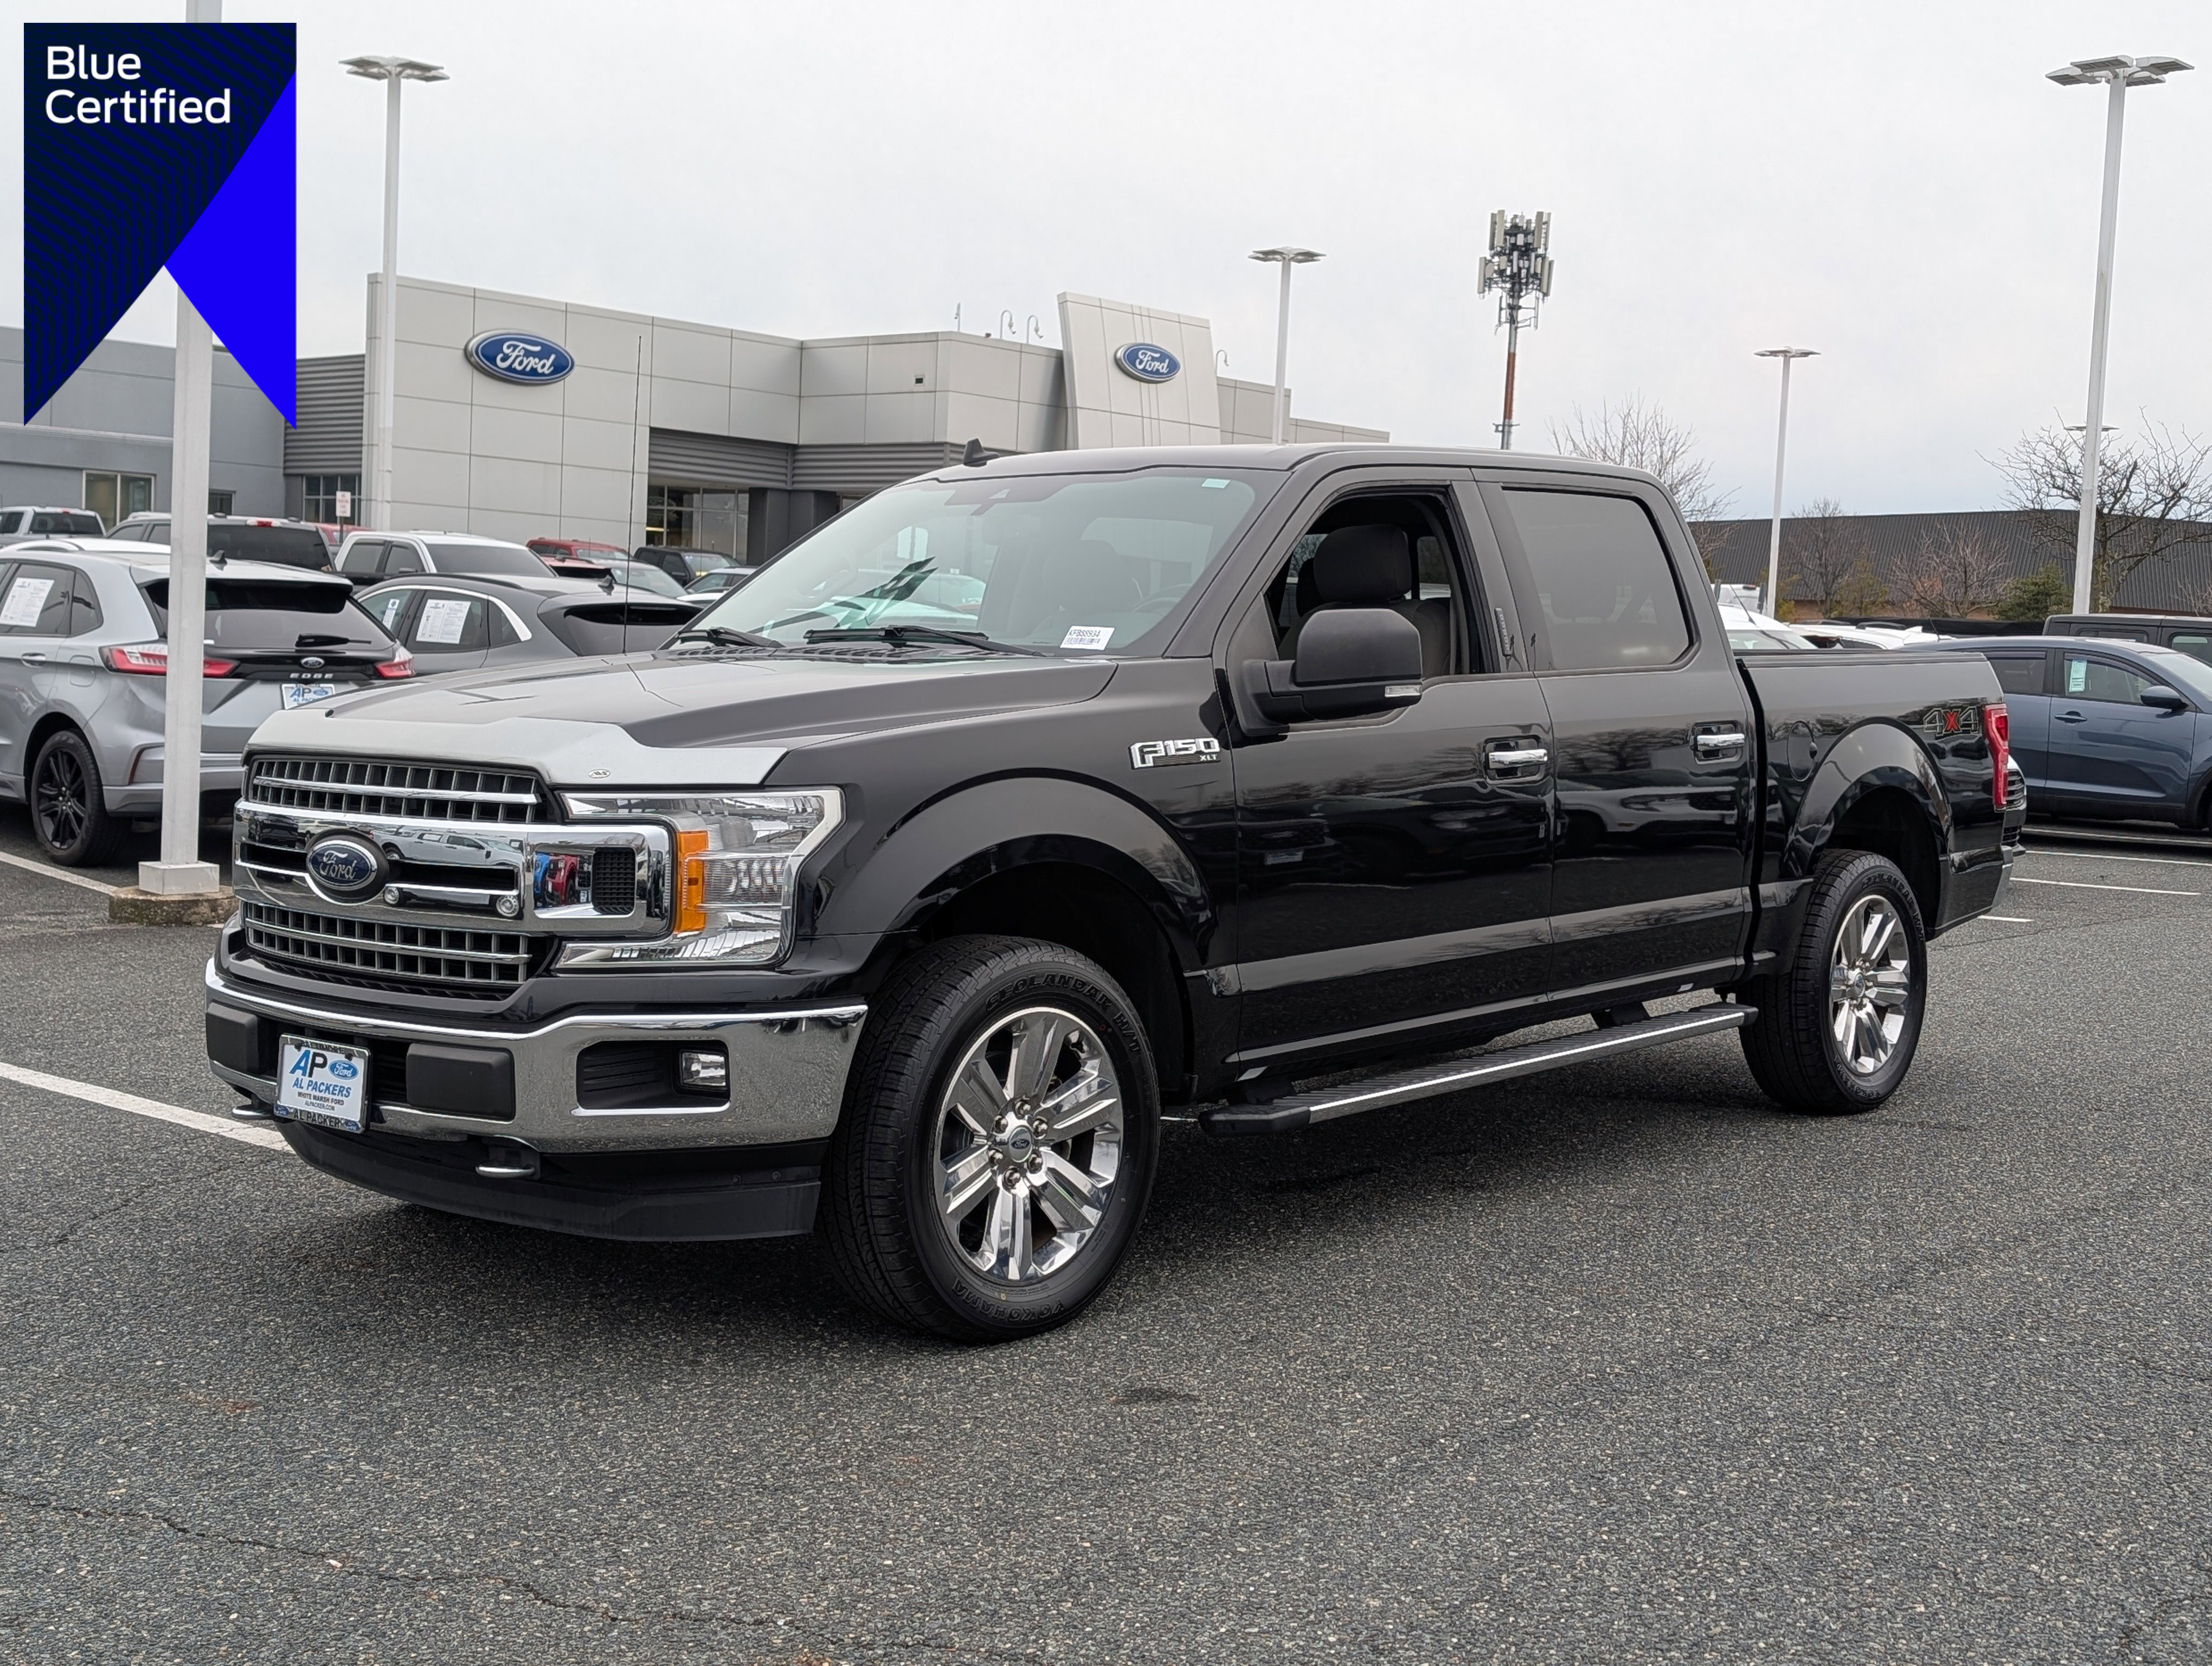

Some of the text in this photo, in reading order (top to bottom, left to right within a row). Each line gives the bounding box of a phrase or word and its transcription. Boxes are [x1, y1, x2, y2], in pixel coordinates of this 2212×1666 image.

[496, 341, 556, 374] Ford
[1136, 350, 1169, 374] Ford
[290, 688, 312, 698] AP
[319, 850, 357, 879] Ford
[289, 1049, 327, 1078] AP
[334, 1063, 353, 1077] Ford
[292, 1077, 352, 1098] AL PACKERS
[298, 1092, 344, 1106] WHITE MARSH FORD
[305, 1100, 335, 1111] ALPACKER.COM
[294, 1111, 340, 1128] AL PACKER
[951, 1278, 1064, 1321] YOKOHAMA
